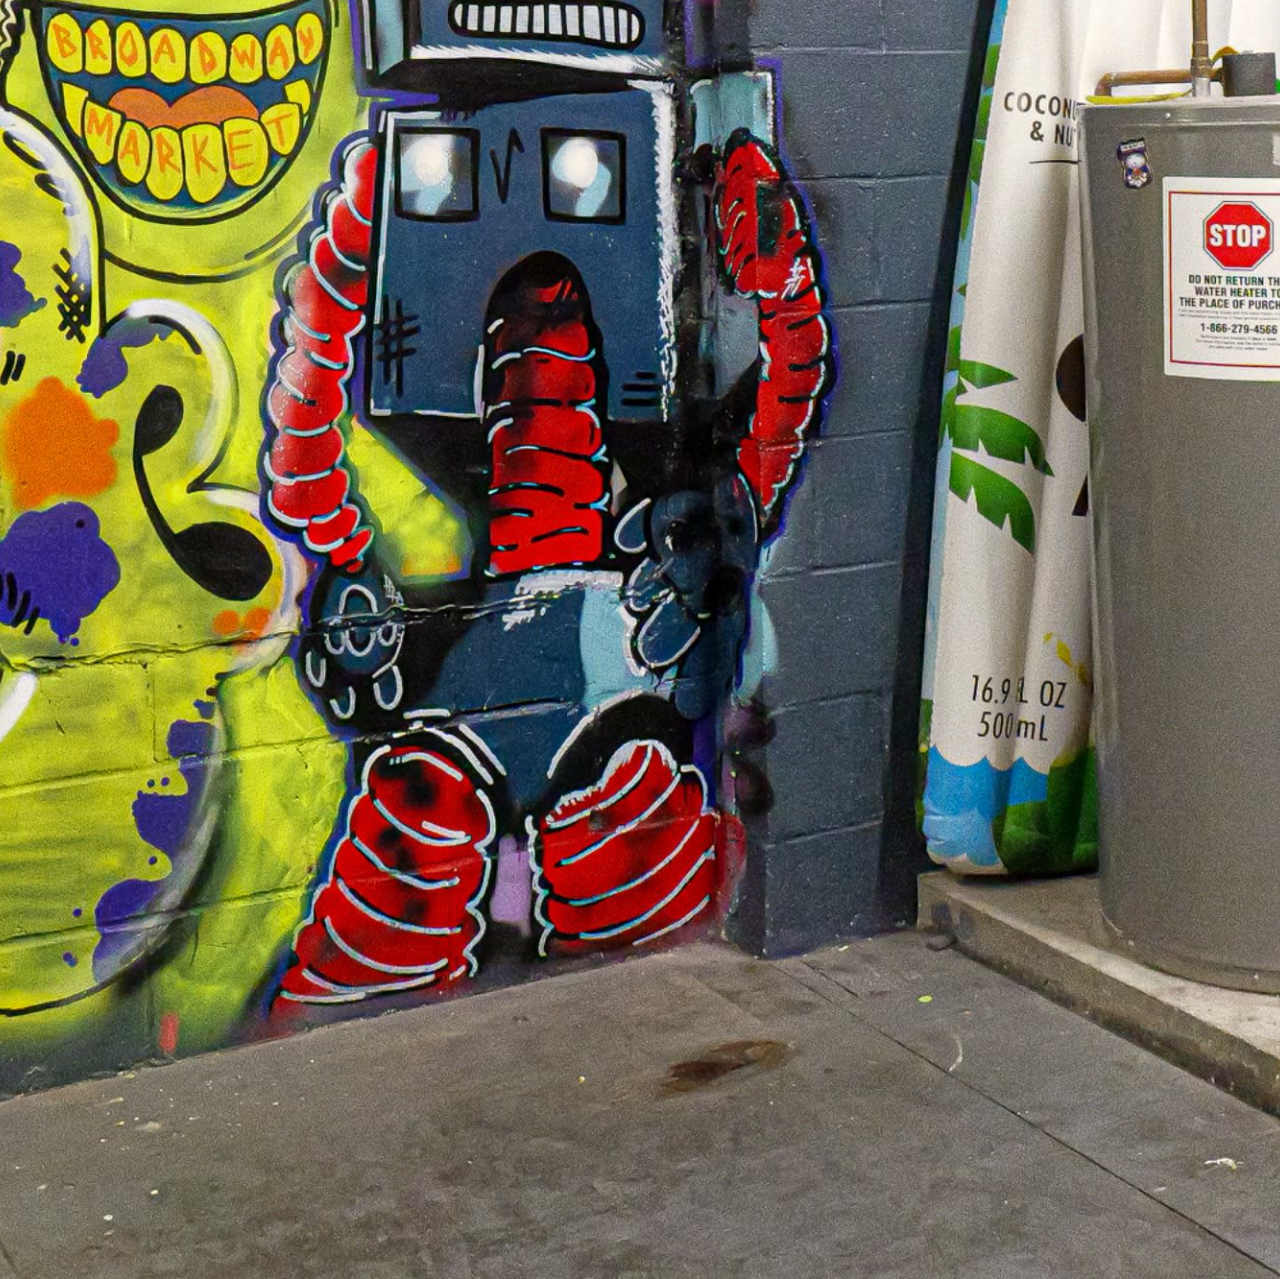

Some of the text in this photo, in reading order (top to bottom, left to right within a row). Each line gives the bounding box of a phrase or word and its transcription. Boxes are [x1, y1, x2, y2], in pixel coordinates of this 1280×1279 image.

[50, 23, 322, 76] BROADWAY
[1030, 121, 1044, 142] &
[86, 109, 293, 177] MARKET
[1209, 223, 1267, 248] STOP
[1188, 274, 1201, 284] DO
[1204, 275, 1222, 285] NOT
[1225, 276, 1264, 286] RETURN
[1195, 286, 1227, 297] WATER
[1230, 287, 1267, 297] HEATER
[1180, 297, 1196, 307] THE
[1199, 298, 1229, 308] PLACE
[1232, 299, 1246, 309] OF
[1200, 323, 1278, 334] 1-866-279-4566
[972, 674, 1011, 704] 16.9
[1040, 680, 1068, 708] OZ
